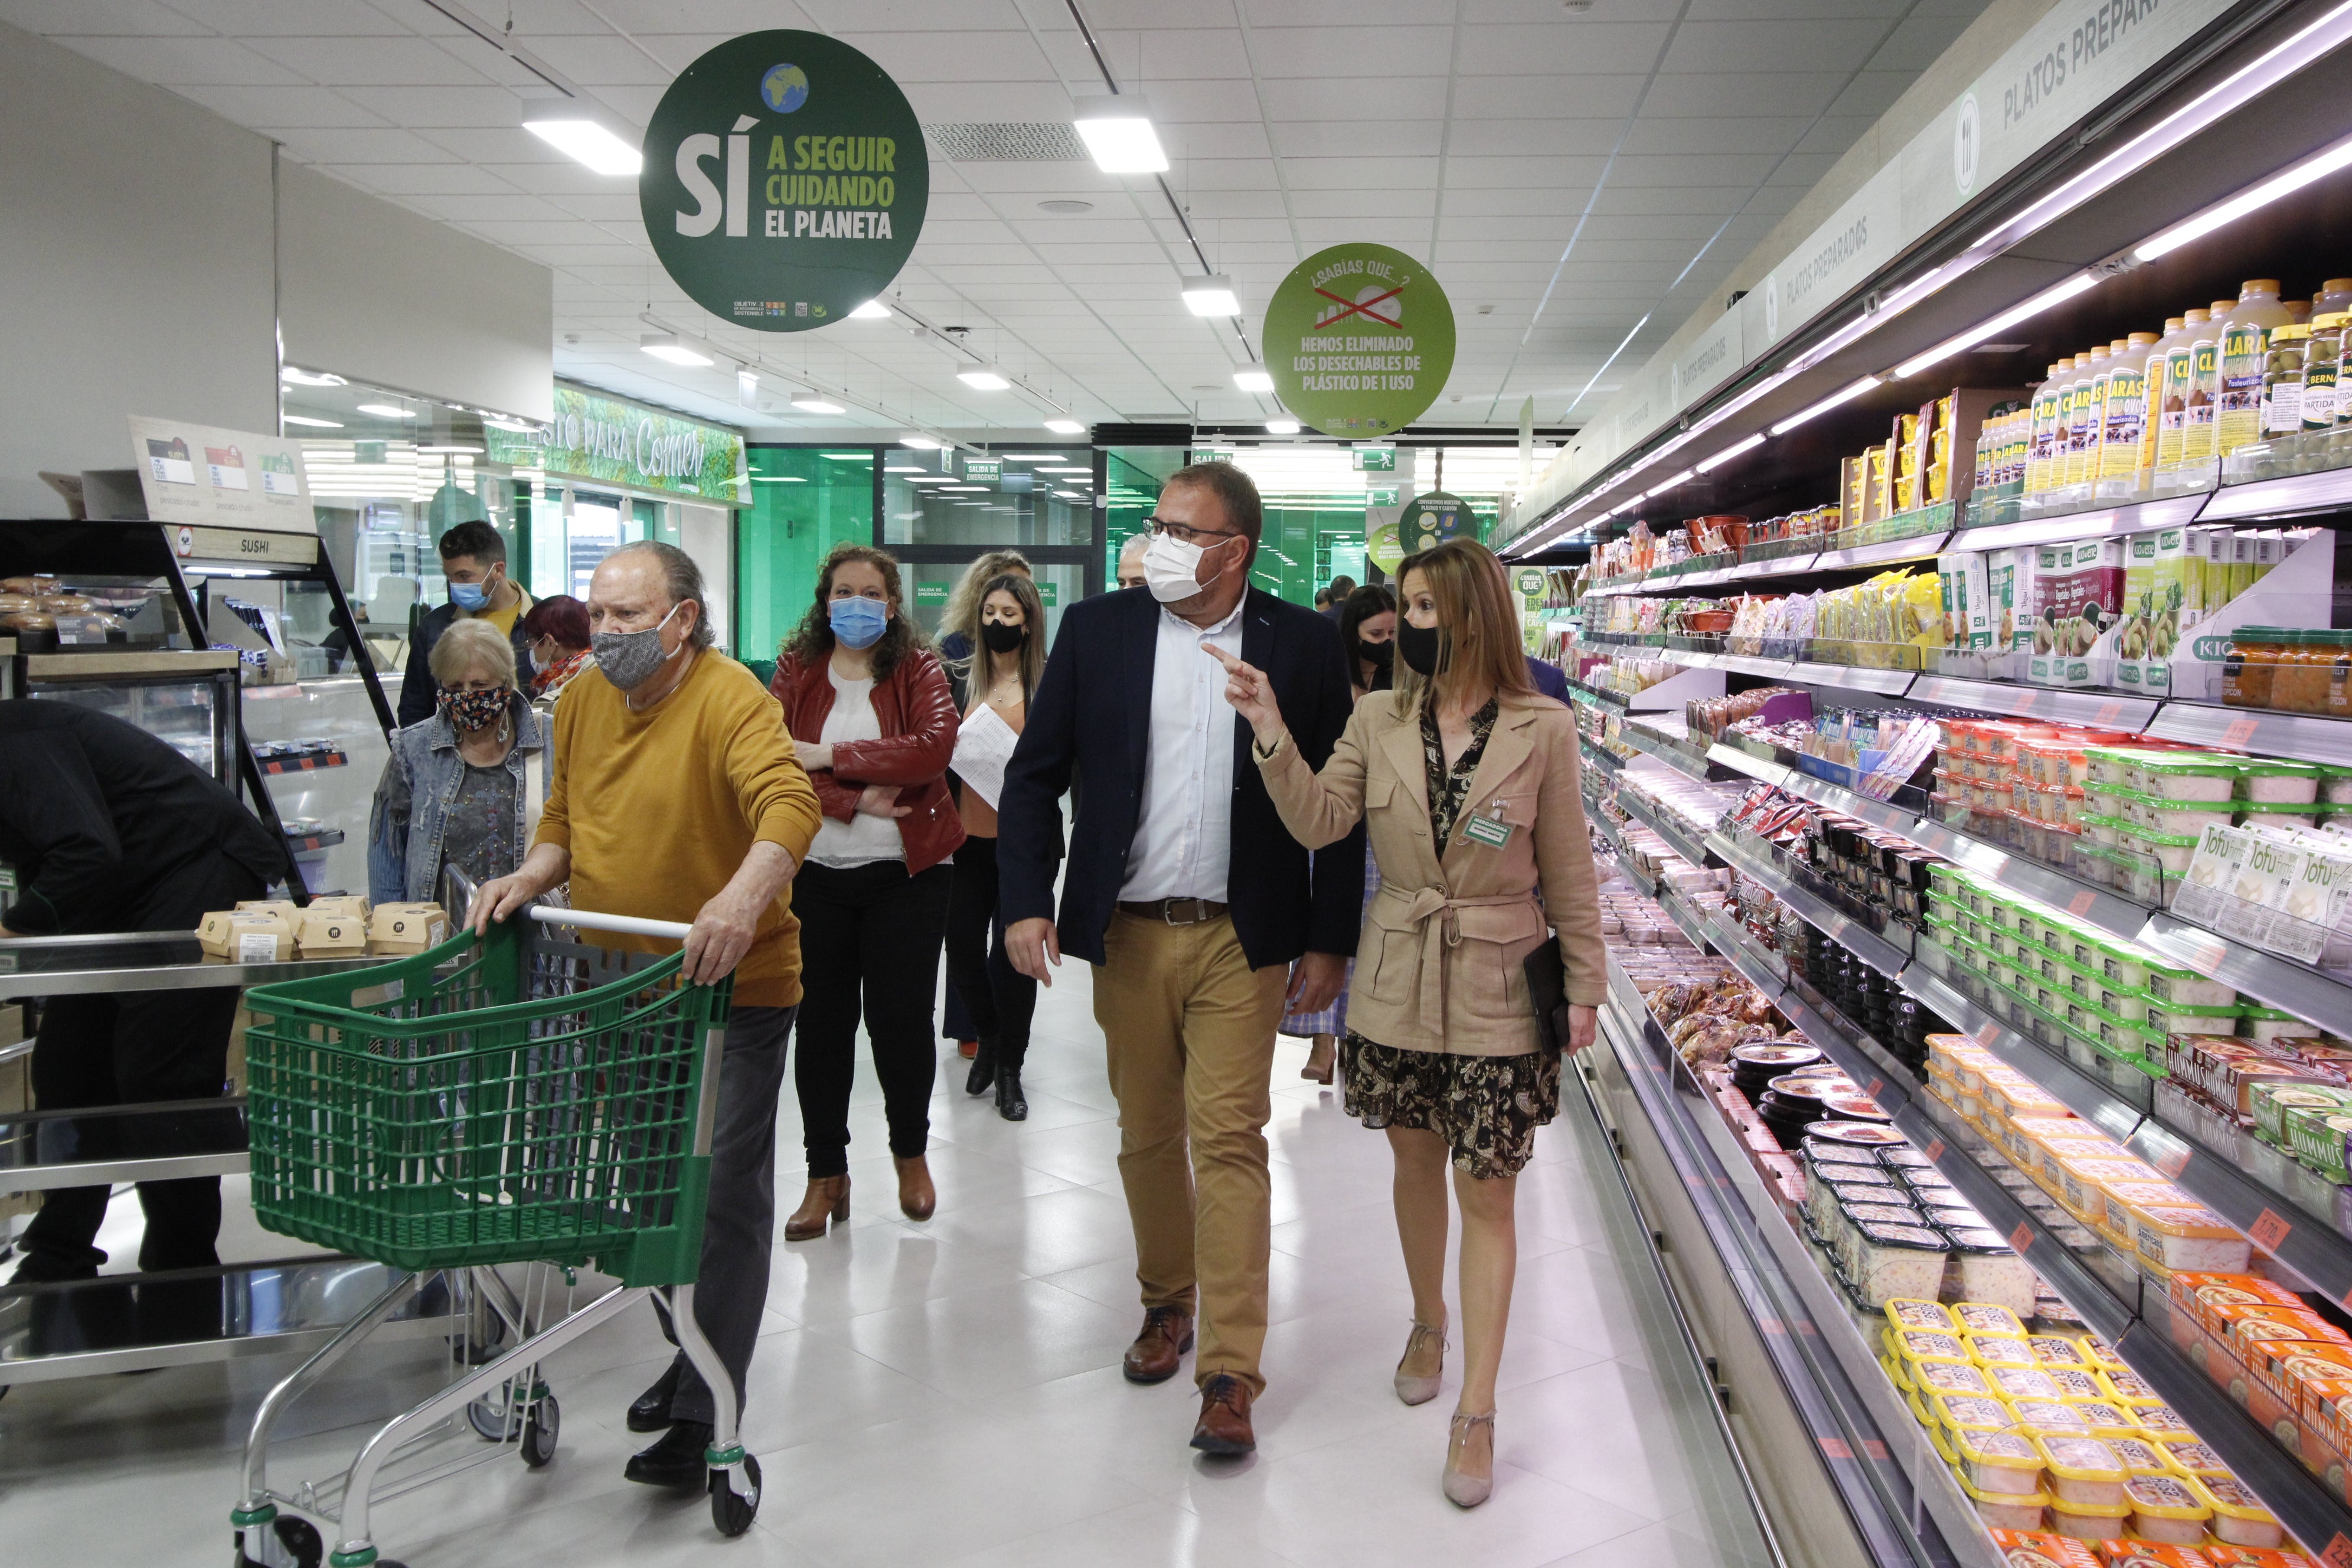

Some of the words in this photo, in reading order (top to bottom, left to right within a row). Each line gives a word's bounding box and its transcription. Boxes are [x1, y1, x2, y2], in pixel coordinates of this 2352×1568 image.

[2004, 43, 2066, 130] PLATOS
[2073, 0, 2158, 74] PREPA
[767, 136, 788, 170] A
[795, 136, 895, 171] SEGUIR
[675, 114, 760, 237] SÍ
[766, 175, 894, 207] CUIDANDO
[765, 210, 789, 237] EL
[795, 211, 892, 239] PLANETA
[1787, 263, 1812, 307] PLATOS
[1814, 215, 1867, 285] PREPARADOS
[1311, 259, 1363, 289] ¿SABÍAS
[1301, 337, 1343, 352] HEMOS
[1346, 337, 1413, 352] ELIMINADO
[2224, 335, 2268, 357] CLARA
[1293, 356, 1316, 371] LOS
[1318, 356, 1402, 371] DESECHABLES
[1404, 356, 1421, 371] DE
[2225, 357, 2252, 377] HUEVO
[1303, 373, 1359, 391] PLÁSTICO
[1362, 375, 1377, 390] DE
[1381, 375, 1386, 390] 1
[1389, 375, 1415, 390] USO
[2112, 380, 2144, 397] ARAS
[2125, 398, 2141, 414] OVO
[2304, 401, 2334, 412] PARTIDA
[2072, 425, 2088, 434] Pasteuriz
[2107, 416, 2138, 425] Pasteurizadas
[584, 418, 631, 462] PARA
[636, 417, 705, 477] Comer
[241, 539, 269, 554] SUSHI
[1523, 580, 1542, 590] QUE?
[1525, 598, 1543, 606] EDES
[1975, 594, 1984, 612] Vegan
[2021, 591, 2031, 609] Vegan
[2200, 641, 2235, 656] KIO
[1474, 818, 1508, 832] MERCADONA
[2204, 826, 2229, 858] Tofu
[2249, 840, 2276, 873] Tofu
[2278, 855, 2295, 879] firme
[2302, 852, 2333, 886] Tofu
[2168, 1049, 2206, 1089] HUMMUS
[2206, 1066, 2237, 1110] HUMMUS
[2160, 1090, 2196, 1132] HUMMUS
[2249, 1100, 2281, 1138] HUMMUS
[2201, 1117, 2239, 1161] HUMMUS
[2290, 1128, 2344, 1170] HUMMUS
[2138, 1228, 2162, 1249] Americana
[2250, 1361, 2297, 1418] HUMMUS
